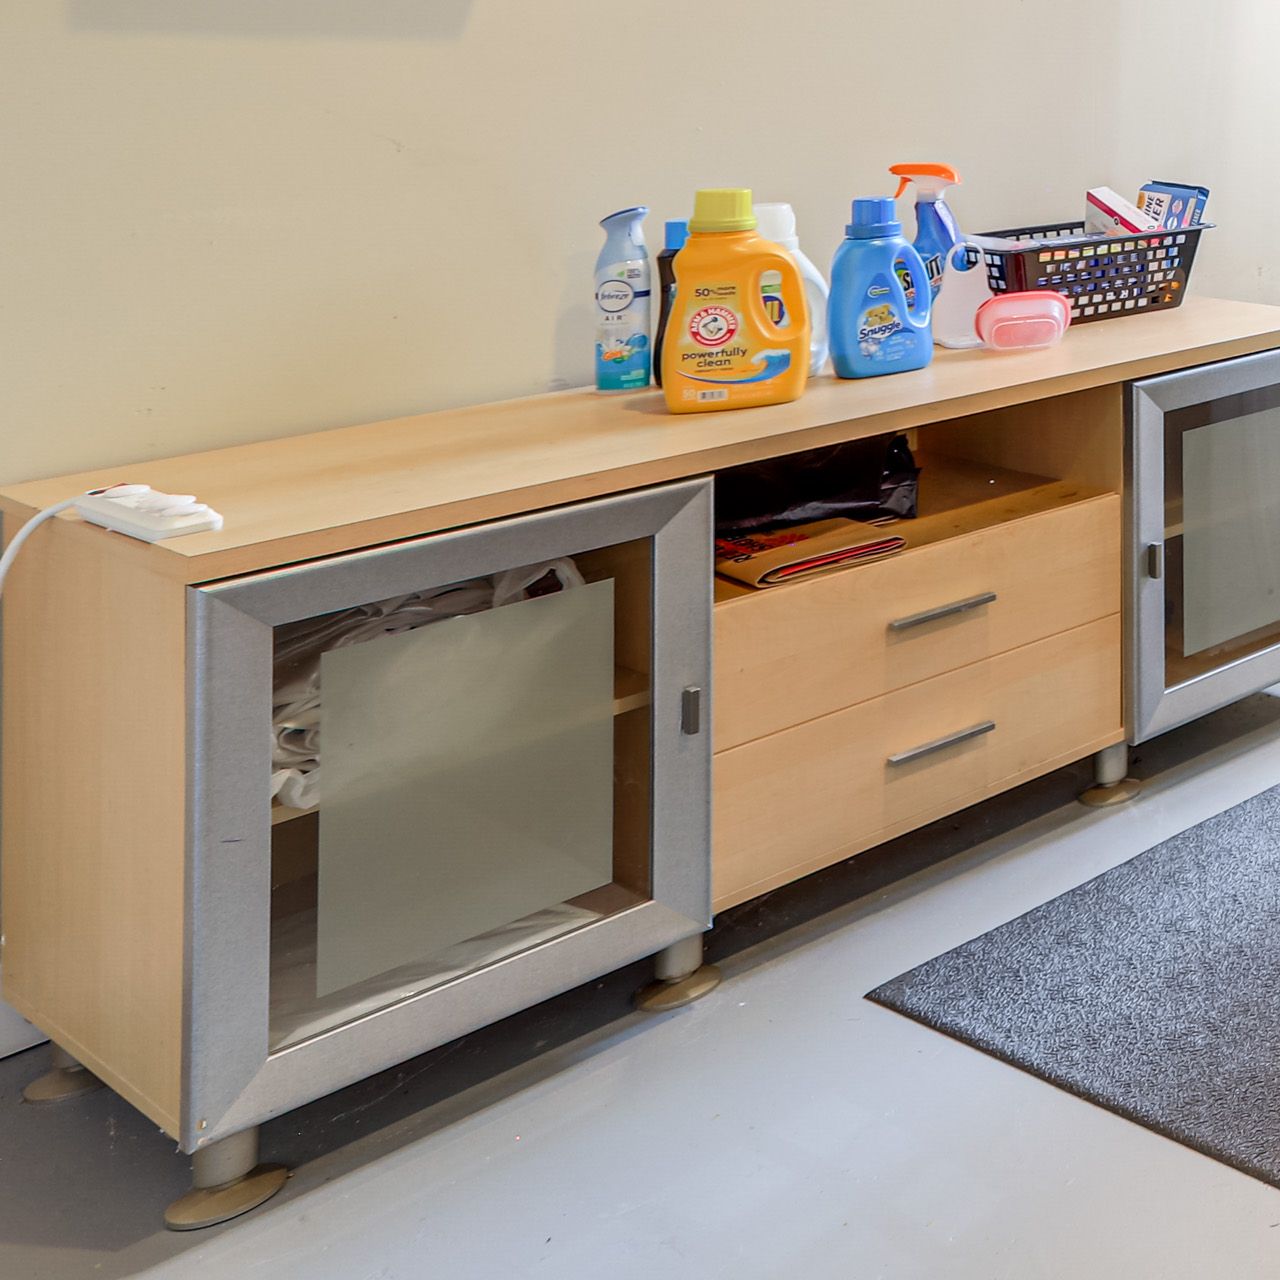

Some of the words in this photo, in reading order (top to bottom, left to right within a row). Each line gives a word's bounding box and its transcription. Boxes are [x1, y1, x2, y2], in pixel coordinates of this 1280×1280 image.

[859, 321, 901, 340] Snuggle
[682, 347, 748, 361] powerfully
[696, 358, 731, 368] clean
